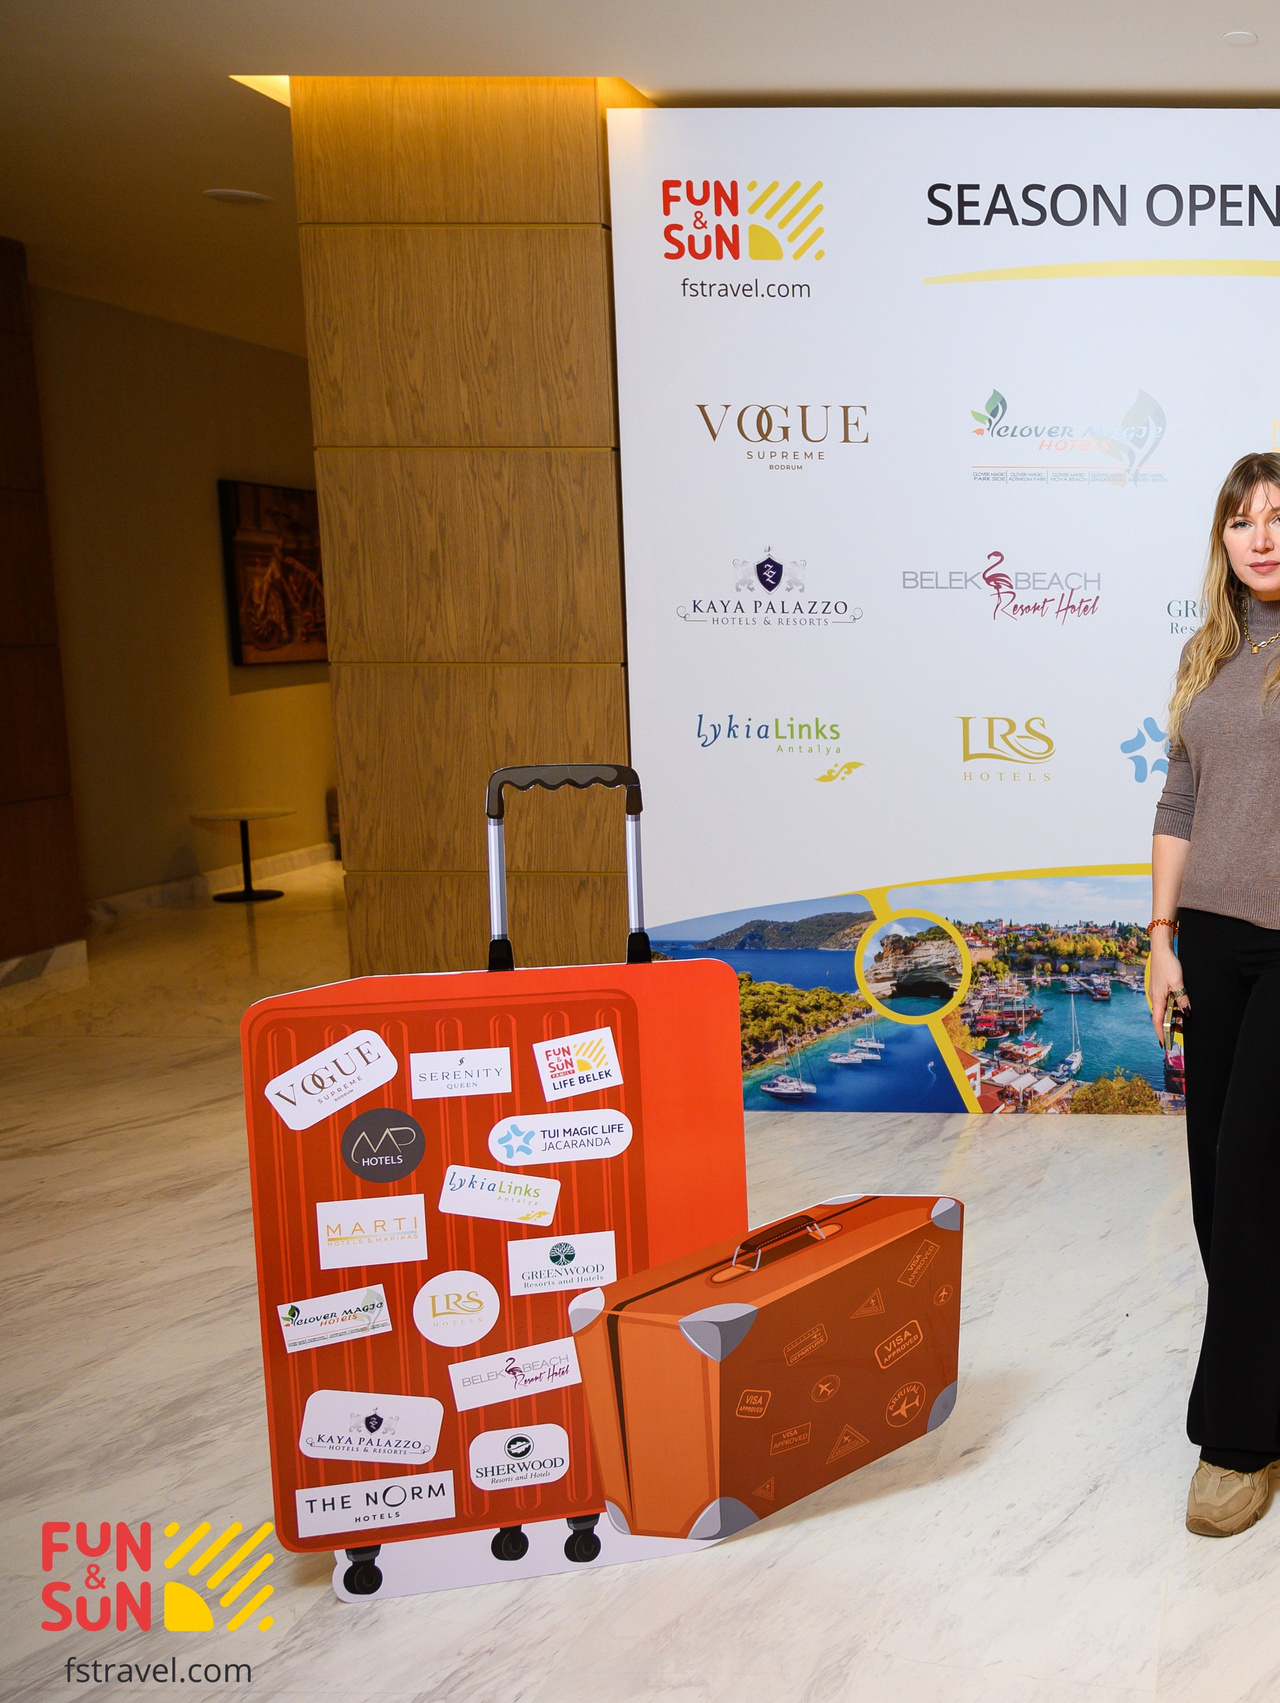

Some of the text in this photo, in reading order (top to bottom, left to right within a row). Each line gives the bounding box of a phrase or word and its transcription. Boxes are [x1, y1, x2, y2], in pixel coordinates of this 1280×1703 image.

[662, 180, 738, 216] FUN
[926, 183, 1127, 227] SEASON
[693, 210, 708, 230] &
[663, 223, 740, 260] SUN
[681, 278, 811, 298] fstravel.com
[696, 404, 869, 444] VOGUE
[996, 425, 1163, 439] CLOVER MAGIC
[1038, 439, 1110, 452] HOTELS
[746, 450, 825, 460] SUPREME
[902, 571, 1101, 591] BELEK BEACH
[692, 599, 848, 615] KAYA PALAZZO
[993, 589, 1100, 625] Resort Hotel
[711, 616, 830, 627] HOTELS & RESORTS
[956, 716, 1056, 764] LRS
[776, 744, 842, 755] Antalya
[963, 771, 1051, 782] HOTELS
[545, 1045, 571, 1061] FUN
[274, 1040, 381, 1107] VOGUE
[418, 1068, 503, 1082] SERENITY
[552, 1069, 612, 1091] LIFE BELEK
[317, 1075, 363, 1105] SUPREME
[540, 1124, 624, 1139] TUI MAGIC LIFE
[541, 1138, 611, 1152] JACARANDA
[362, 1155, 403, 1167] HOTELS
[497, 1196, 539, 1206] Antalya
[326, 1216, 418, 1237] MARTI
[328, 1239, 364, 1247] HOTELS
[376, 1234, 419, 1243] MARINAS
[908, 1254, 922, 1272] VISA
[908, 1245, 934, 1283] APPROVED
[521, 1263, 605, 1281] GREENWOOD
[524, 1280, 556, 1289] Resorts
[577, 1274, 604, 1283] Hotels
[428, 1290, 485, 1319] LRS
[296, 1312, 337, 1326] CLOVER
[320, 1314, 358, 1327] HOTELS
[433, 1317, 483, 1327] HOTELS
[790, 1337, 825, 1363] DEPARTURE
[884, 1330, 912, 1353] VISA
[884, 1334, 919, 1364] APPROVED
[462, 1354, 569, 1387] BELEK BEACH
[746, 1395, 763, 1405] VISA
[888, 1384, 920, 1411] ARRIVAL
[317, 1434, 422, 1450] KAYA PALAZZO
[773, 1432, 808, 1449] APPROVED
[782, 1429, 798, 1439] VISA
[329, 1445, 360, 1453] HOTELS
[475, 1457, 565, 1479] SHERWOOD
[491, 1475, 514, 1484] Resorts
[530, 1471, 551, 1479] Hotels
[305, 1482, 446, 1514] THE NORM
[355, 1511, 400, 1523] HOTELS
